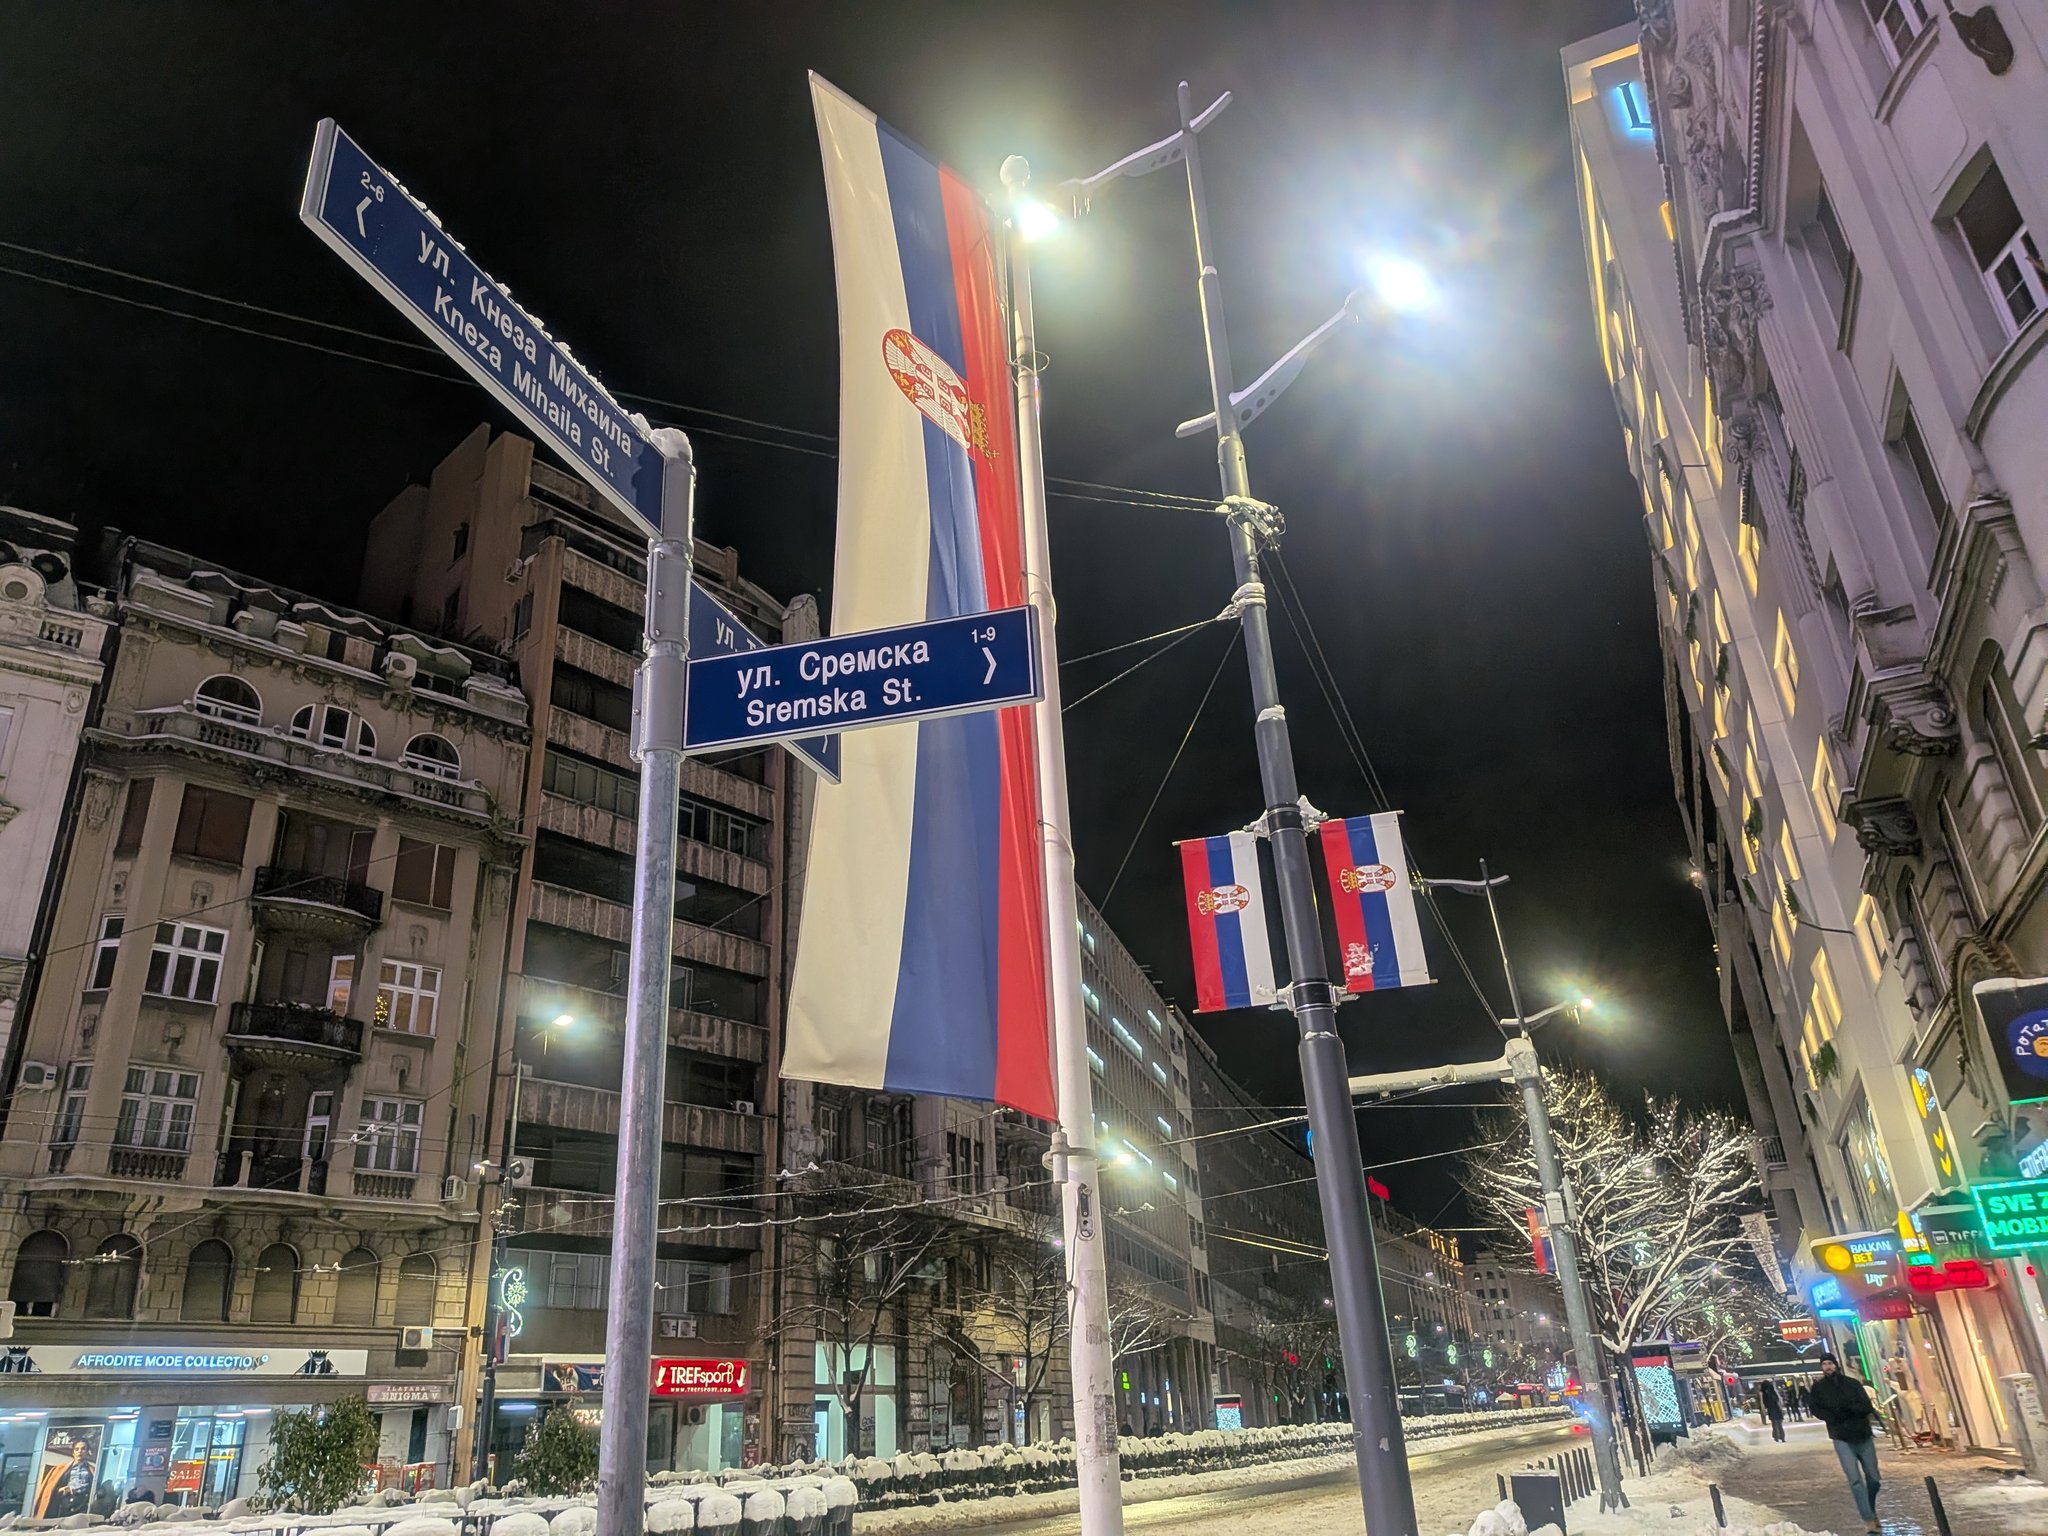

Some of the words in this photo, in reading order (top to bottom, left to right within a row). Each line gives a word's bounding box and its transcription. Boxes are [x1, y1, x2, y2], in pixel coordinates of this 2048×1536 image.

[360, 171, 385, 202] 2-6
[418, 230, 456, 285] ул.
[470, 276, 537, 364] Кнеза
[549, 352, 632, 458] Михаила
[434, 286, 501, 372] Kneza
[513, 360, 581, 447] Mihaila
[590, 435, 614, 477] St.
[971, 627, 997, 644] 1-9
[737, 665, 781, 698] ул.
[799, 640, 930, 686] Сремска
[746, 687, 867, 727] Sremska
[883, 678, 921, 706] St.
[1988, 1193, 2037, 1213] SVE
[1850, 1240, 1892, 1253] BALKAN
[1853, 1252, 1873, 1263] BET
[77, 1355, 143, 1367] AFRODITE
[144, 1355, 182, 1367] MODE
[381, 1392, 429, 1401] ENIGMA
[169, 1469, 201, 1480] SALE
